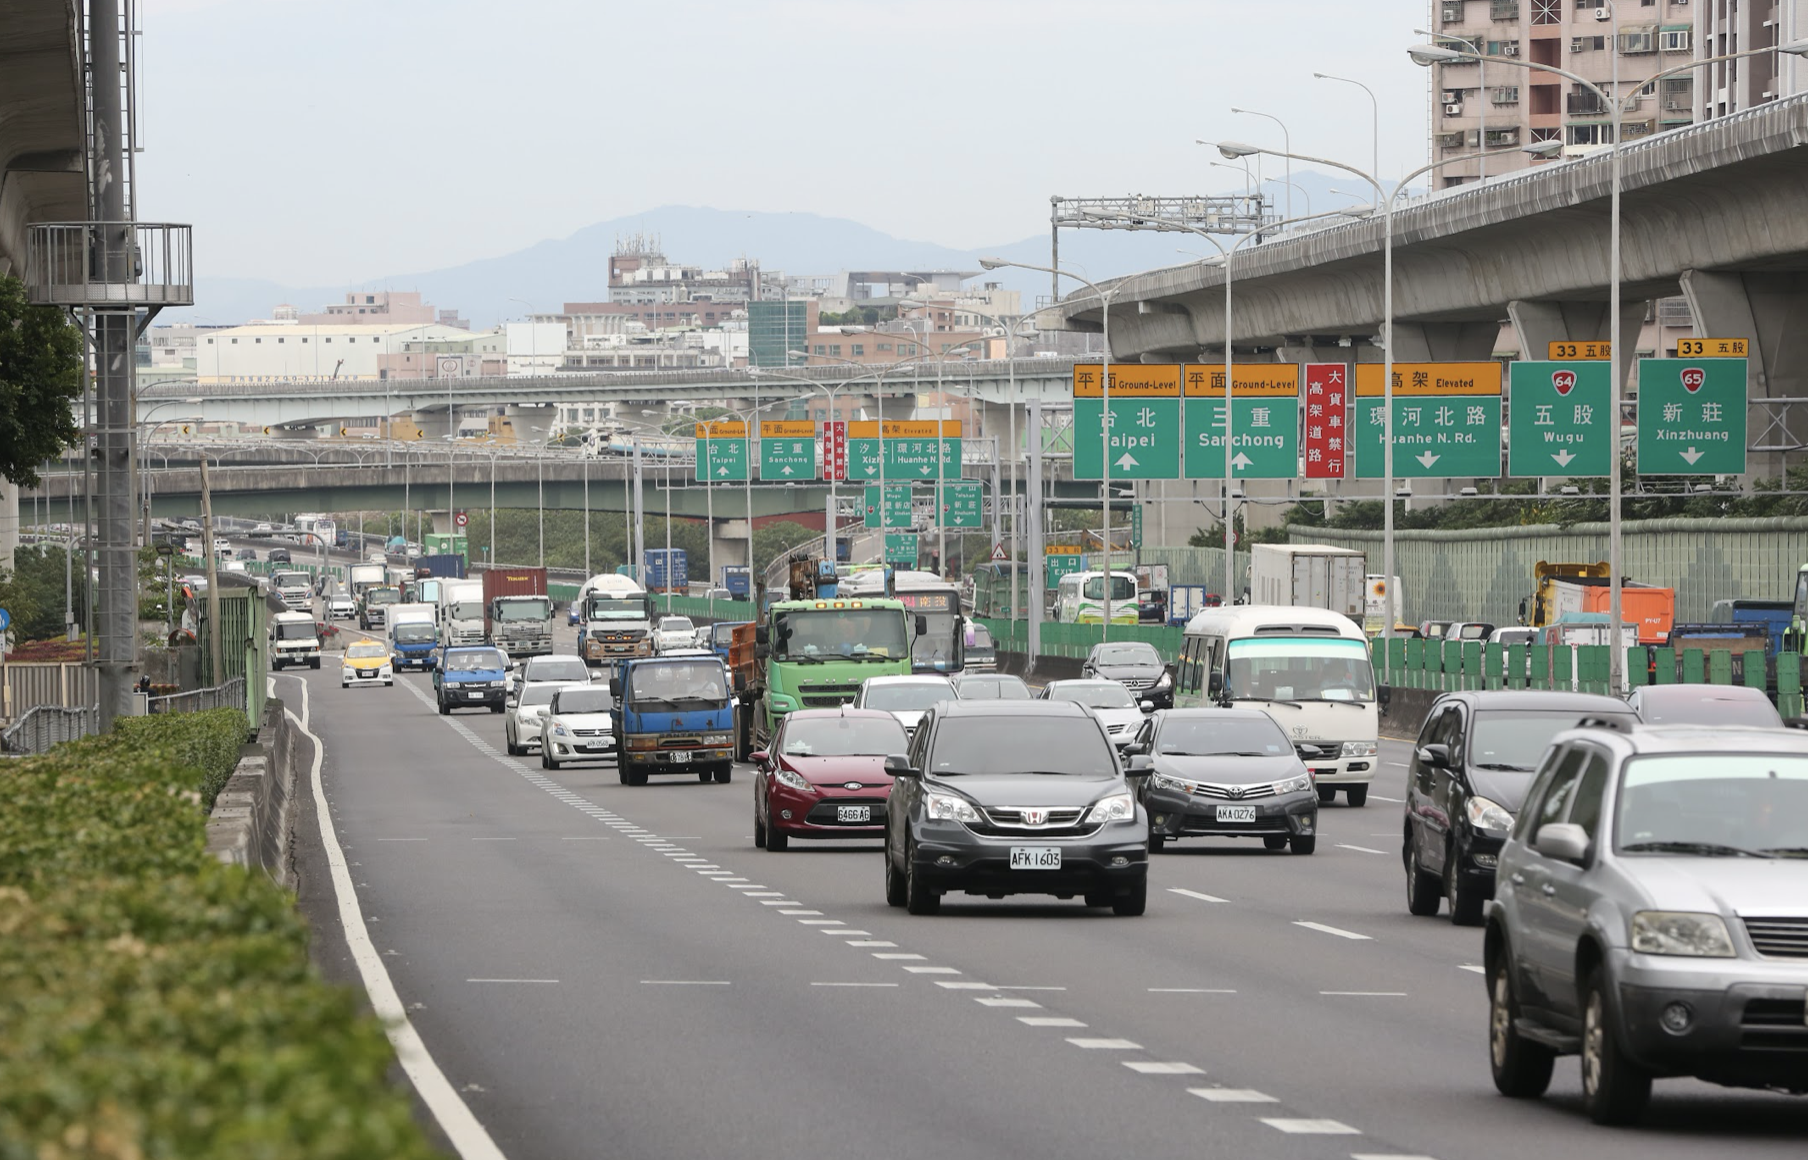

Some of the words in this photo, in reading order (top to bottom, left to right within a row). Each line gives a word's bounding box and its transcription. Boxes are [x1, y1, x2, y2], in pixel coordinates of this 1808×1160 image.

[1557, 345, 1577, 357] 33
[1585, 345, 1611, 357] 五股
[1682, 342, 1703, 354] 33
[1718, 342, 1744, 354] 五股
[1078, 372, 1116, 389] 平面
[1119, 380, 1176, 389] Ground-Level
[1189, 372, 1226, 389] 平面
[1232, 380, 1295, 389] Ground-Level
[1391, 371, 1428, 388] 高架
[1436, 378, 1474, 388] Elevated
[1555, 376, 1572, 387] 64
[1684, 373, 1702, 384] 65
[1098, 407, 1156, 428] 台北
[1211, 407, 1271, 427] 三重
[1370, 406, 1486, 427] 環河北路
[1534, 404, 1593, 425] 五股
[1663, 402, 1722, 423] 新莊
[1308, 381, 1323, 462] 高架道路
[1328, 370, 1342, 473] 大貨車禁行
[1437, 432, 1451, 444] N.
[1455, 432, 1476, 444] Rd.
[1544, 431, 1584, 444] Wugu
[1656, 429, 1729, 442] Xinzhuang
[773, 442, 803, 454] 三重
[712, 457, 736, 465] Taipei
[768, 456, 808, 464] Sanchong
[897, 456, 928, 464] Huanhe
[1051, 558, 1077, 567] 出口
